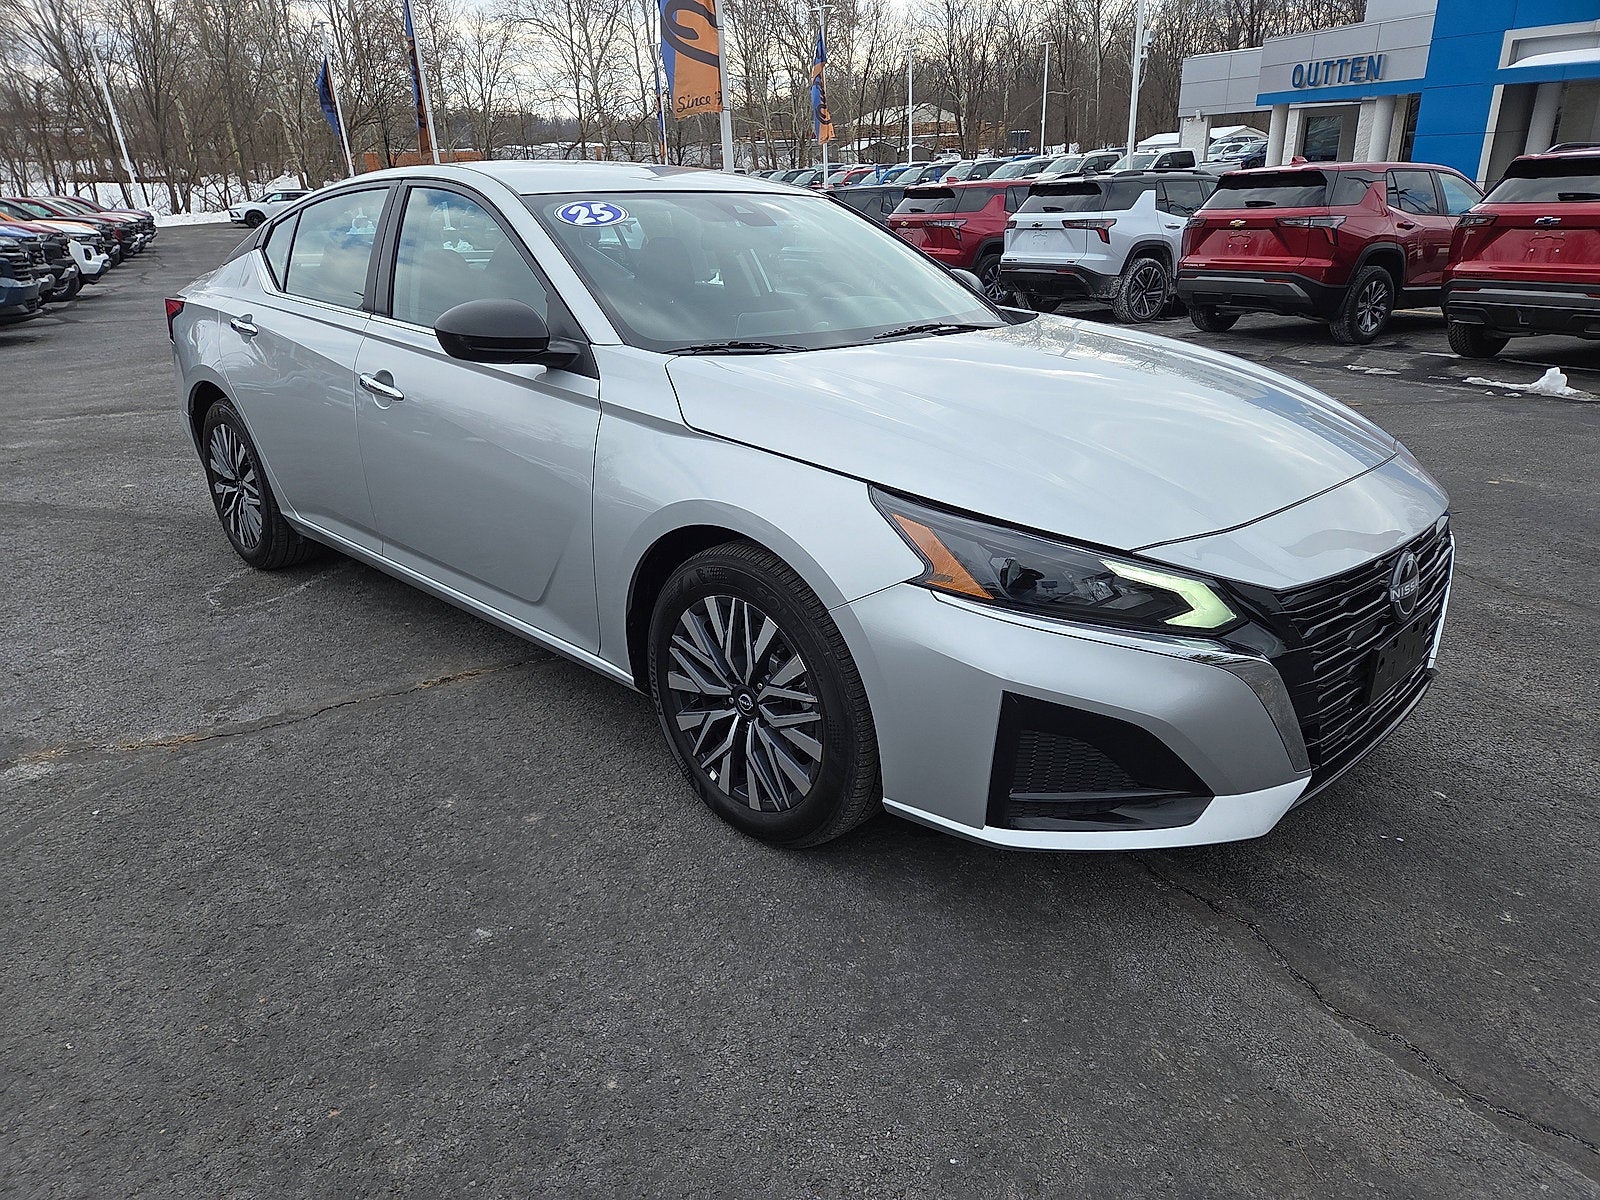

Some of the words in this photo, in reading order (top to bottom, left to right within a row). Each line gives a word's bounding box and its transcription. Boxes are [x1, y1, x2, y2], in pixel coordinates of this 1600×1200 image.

[1292, 54, 1385, 88] OUTTEN
[676, 95, 711, 113] Since
[568, 203, 615, 224] 25
[1391, 581, 1418, 600] NISS
